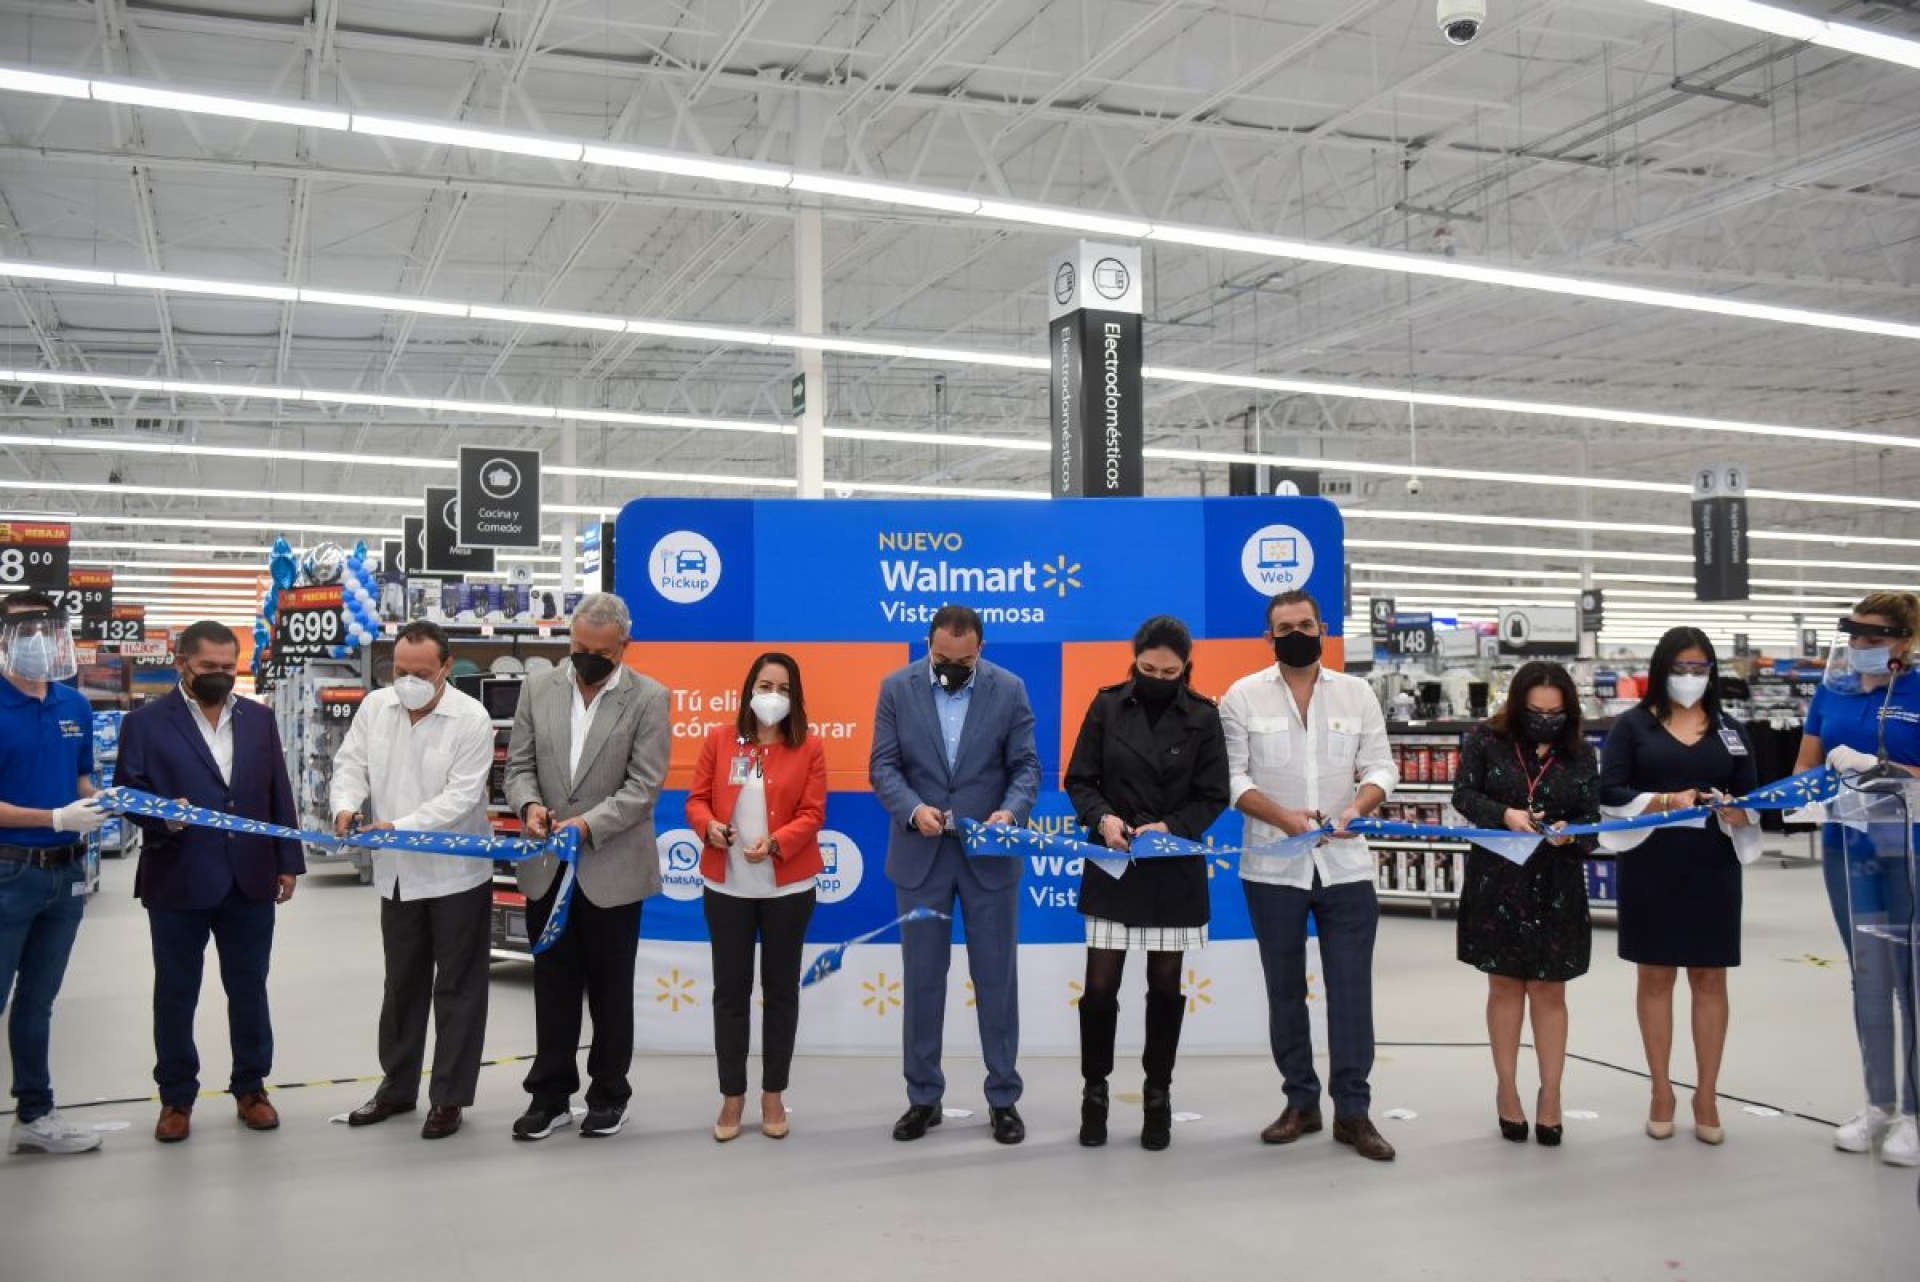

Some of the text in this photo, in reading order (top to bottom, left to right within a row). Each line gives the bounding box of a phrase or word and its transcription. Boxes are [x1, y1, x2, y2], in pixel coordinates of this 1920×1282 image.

[1104, 322, 1122, 490] Electrodomésticos
[478, 507, 520, 521] Cocina y
[476, 521, 522, 534] Comedor
[879, 532, 963, 551] NUEVO
[661, 575, 710, 593] Pickup
[879, 560, 1037, 592] Walmart
[1260, 570, 1294, 584] Web
[672, 689, 702, 712] Tú
